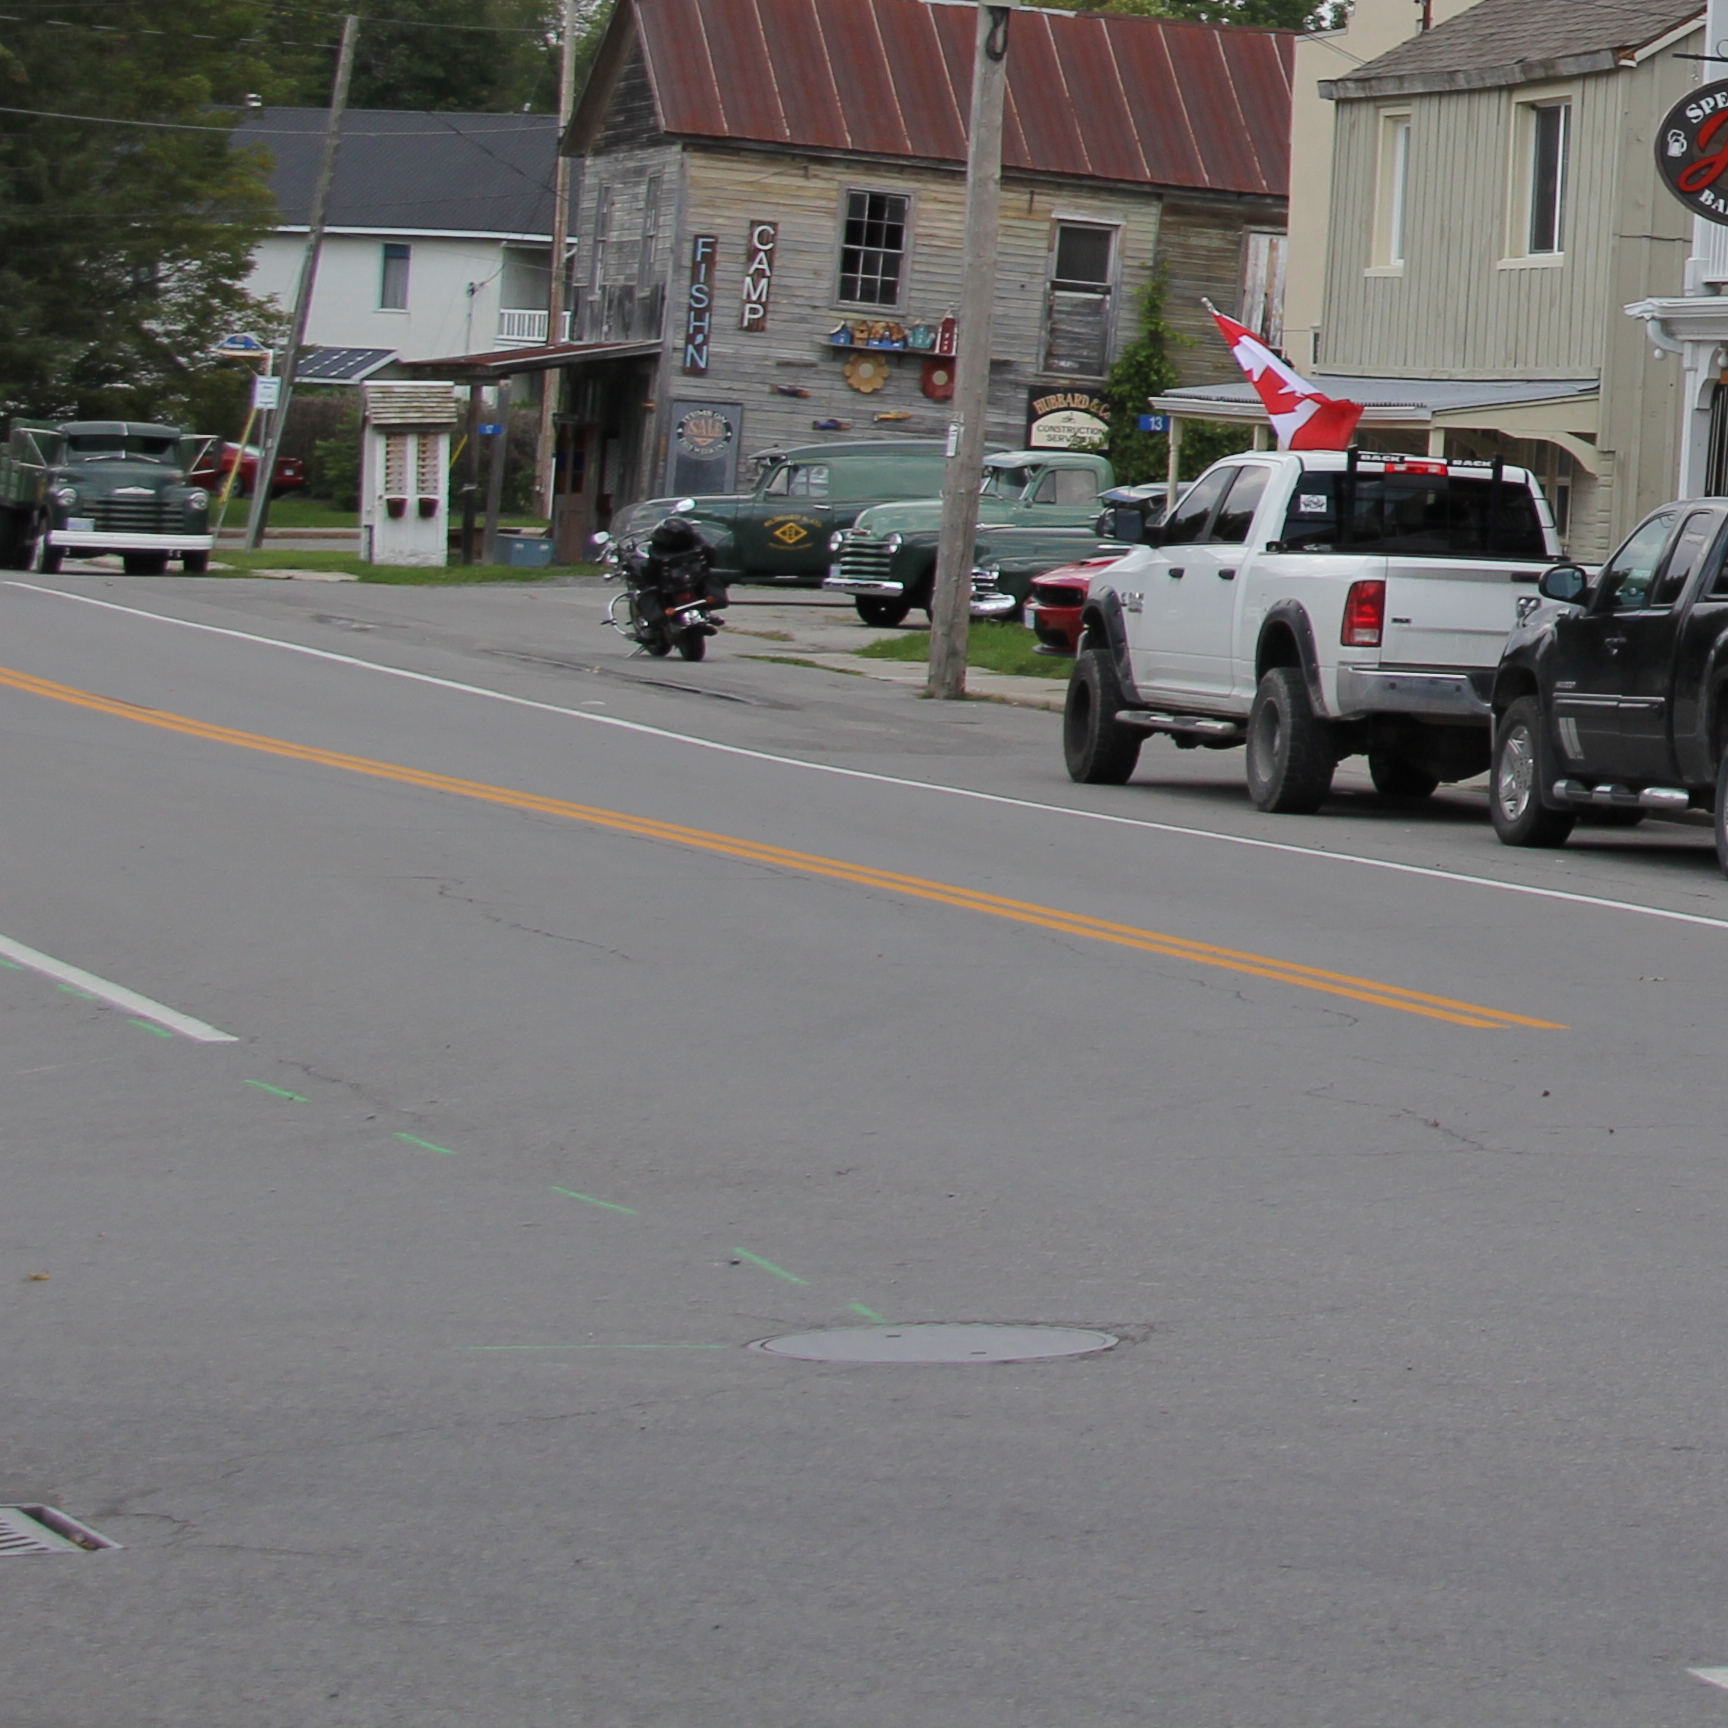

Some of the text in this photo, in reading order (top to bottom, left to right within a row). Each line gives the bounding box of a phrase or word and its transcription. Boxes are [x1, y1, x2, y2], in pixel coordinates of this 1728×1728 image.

[742, 224, 776, 328] CAMP
[1032, 392, 1090, 415] HUBBARD
[1149, 416, 1163, 431] 13
[1360, 454, 1401, 463] BACK
